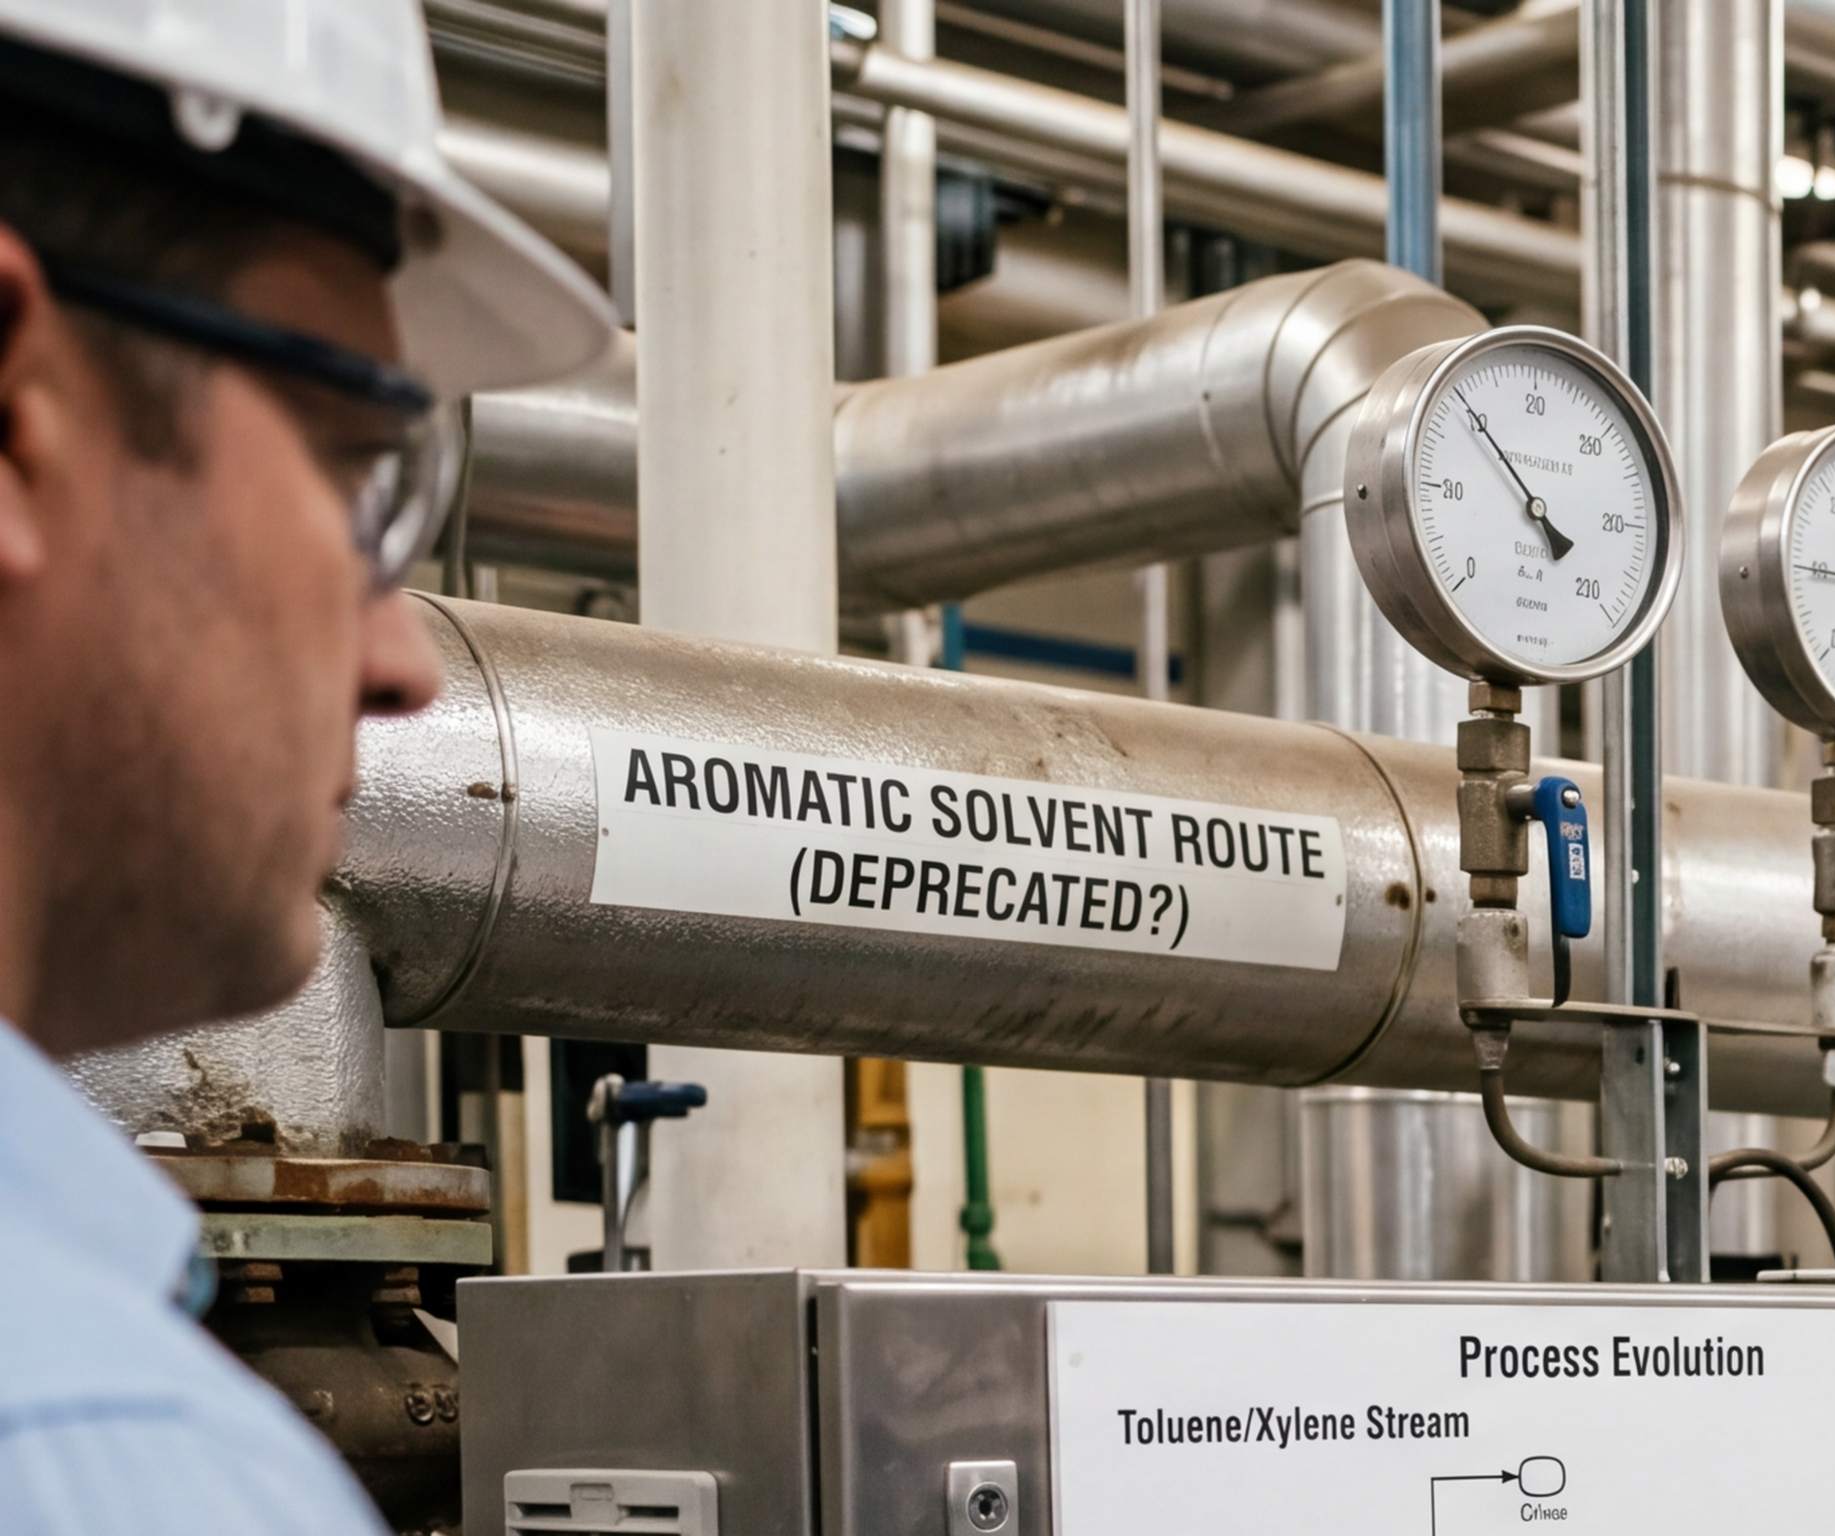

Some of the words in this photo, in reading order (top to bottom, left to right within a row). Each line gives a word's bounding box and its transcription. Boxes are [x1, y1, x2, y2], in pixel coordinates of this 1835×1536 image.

[624, 748, 912, 833] AROMATIC
[930, 785, 1153, 859] SOLVENT
[1171, 813, 1325, 879] ROUTE
[790, 847, 1189, 950] (DEPRECATED?)
[1459, 1335, 1599, 1379] Process
[1612, 1336, 1764, 1377] Evolution
[1117, 1406, 1355, 1450] Toluene/Xylene
[1366, 1404, 1469, 1440] Stream
